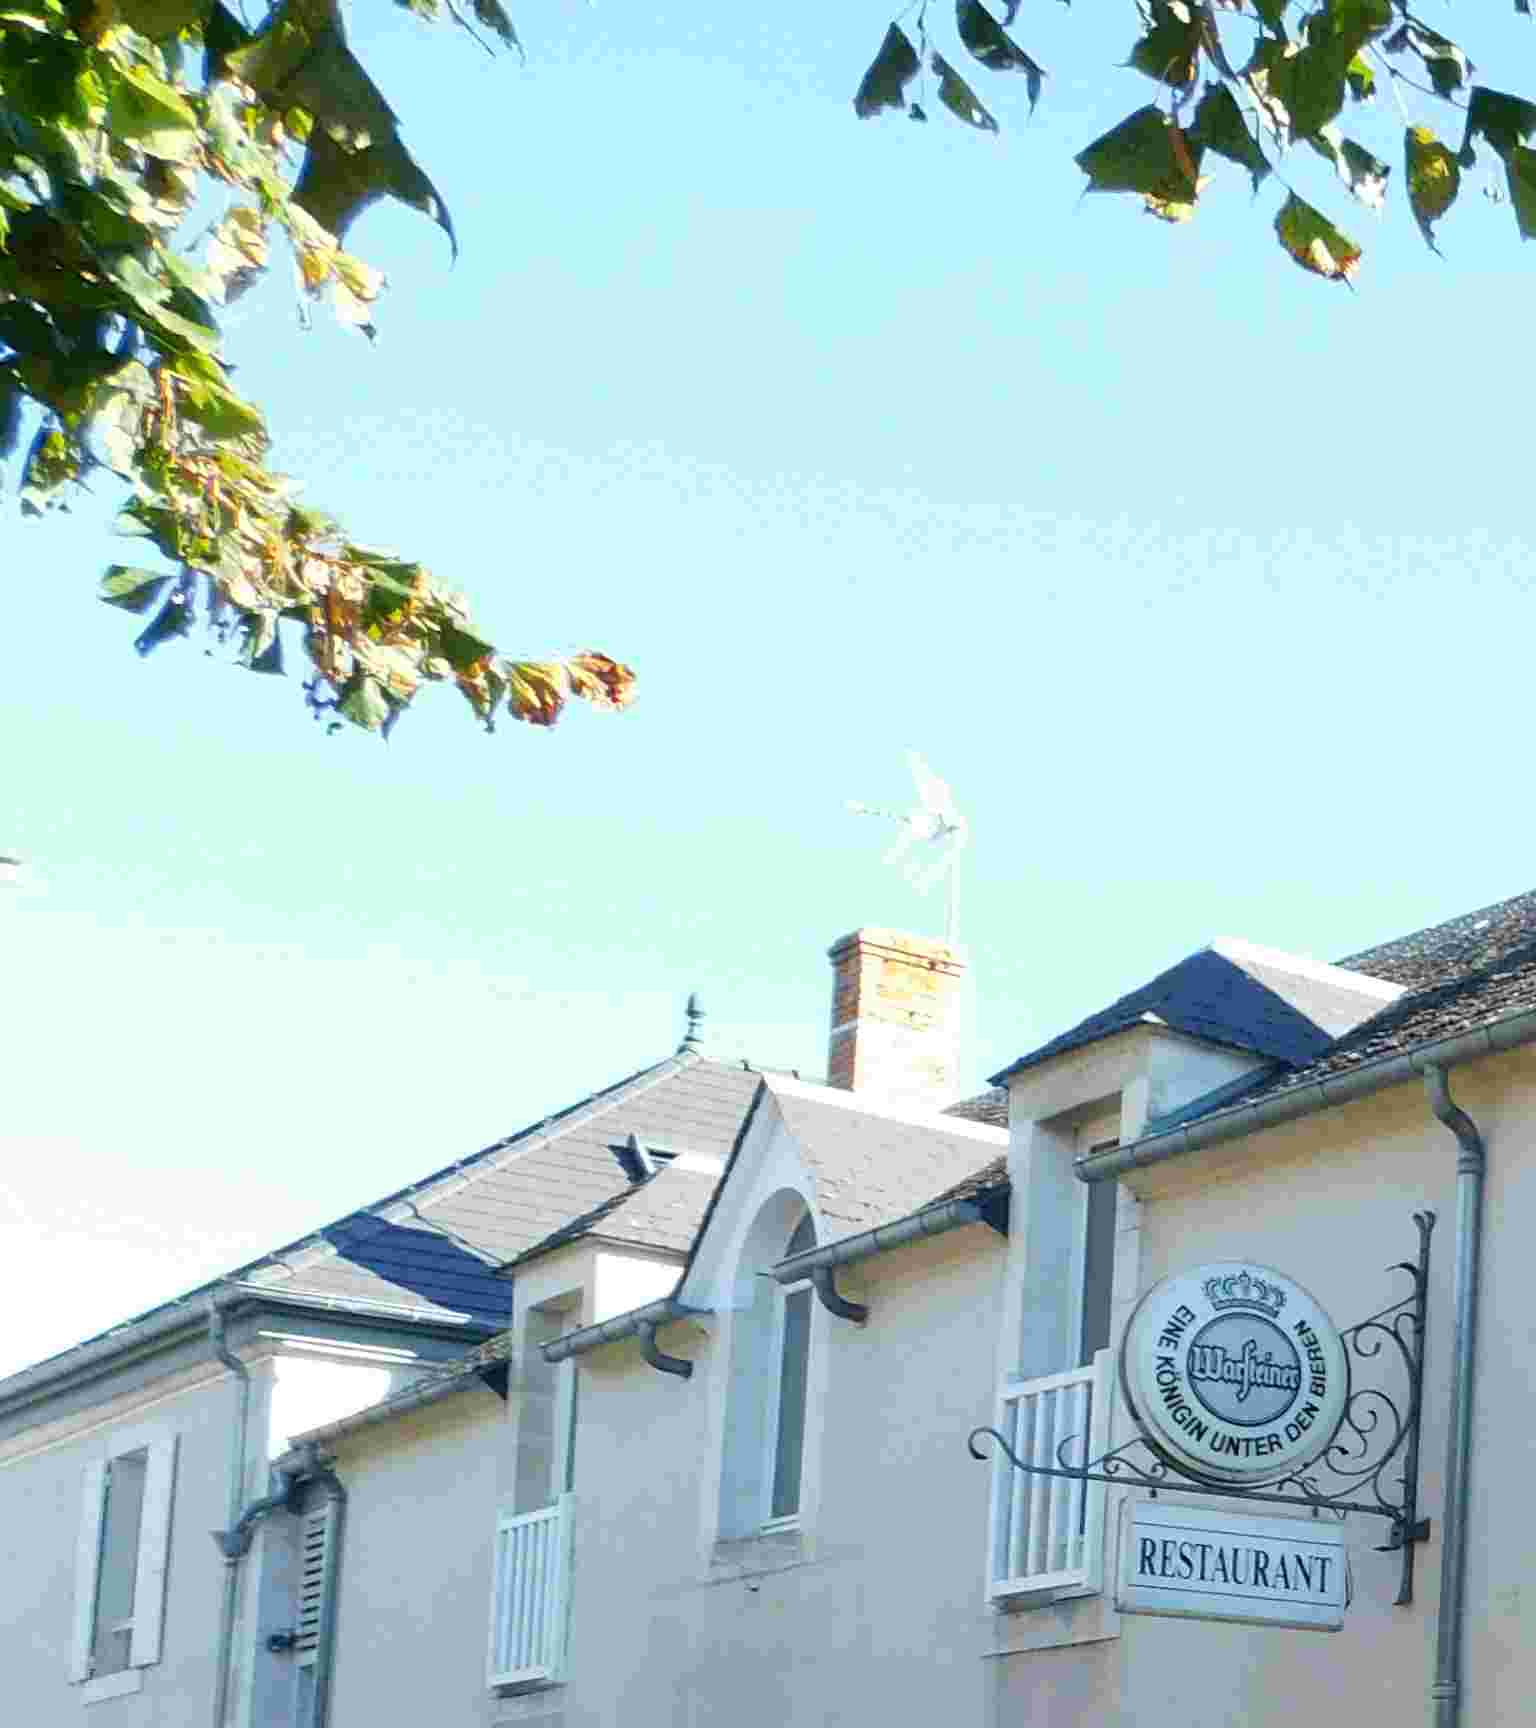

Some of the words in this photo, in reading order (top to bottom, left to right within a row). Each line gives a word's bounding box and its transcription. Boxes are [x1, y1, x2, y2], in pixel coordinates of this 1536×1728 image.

[1156, 1304, 1197, 1351] EINE
[1293, 1319, 1327, 1398] BIEREN
[1155, 1355, 1209, 1443] KÖNIGIN
[1284, 1401, 1320, 1442] DEN
[1209, 1432, 1283, 1457] UNTER
[1138, 1536, 1333, 1594] RESTAURANT
